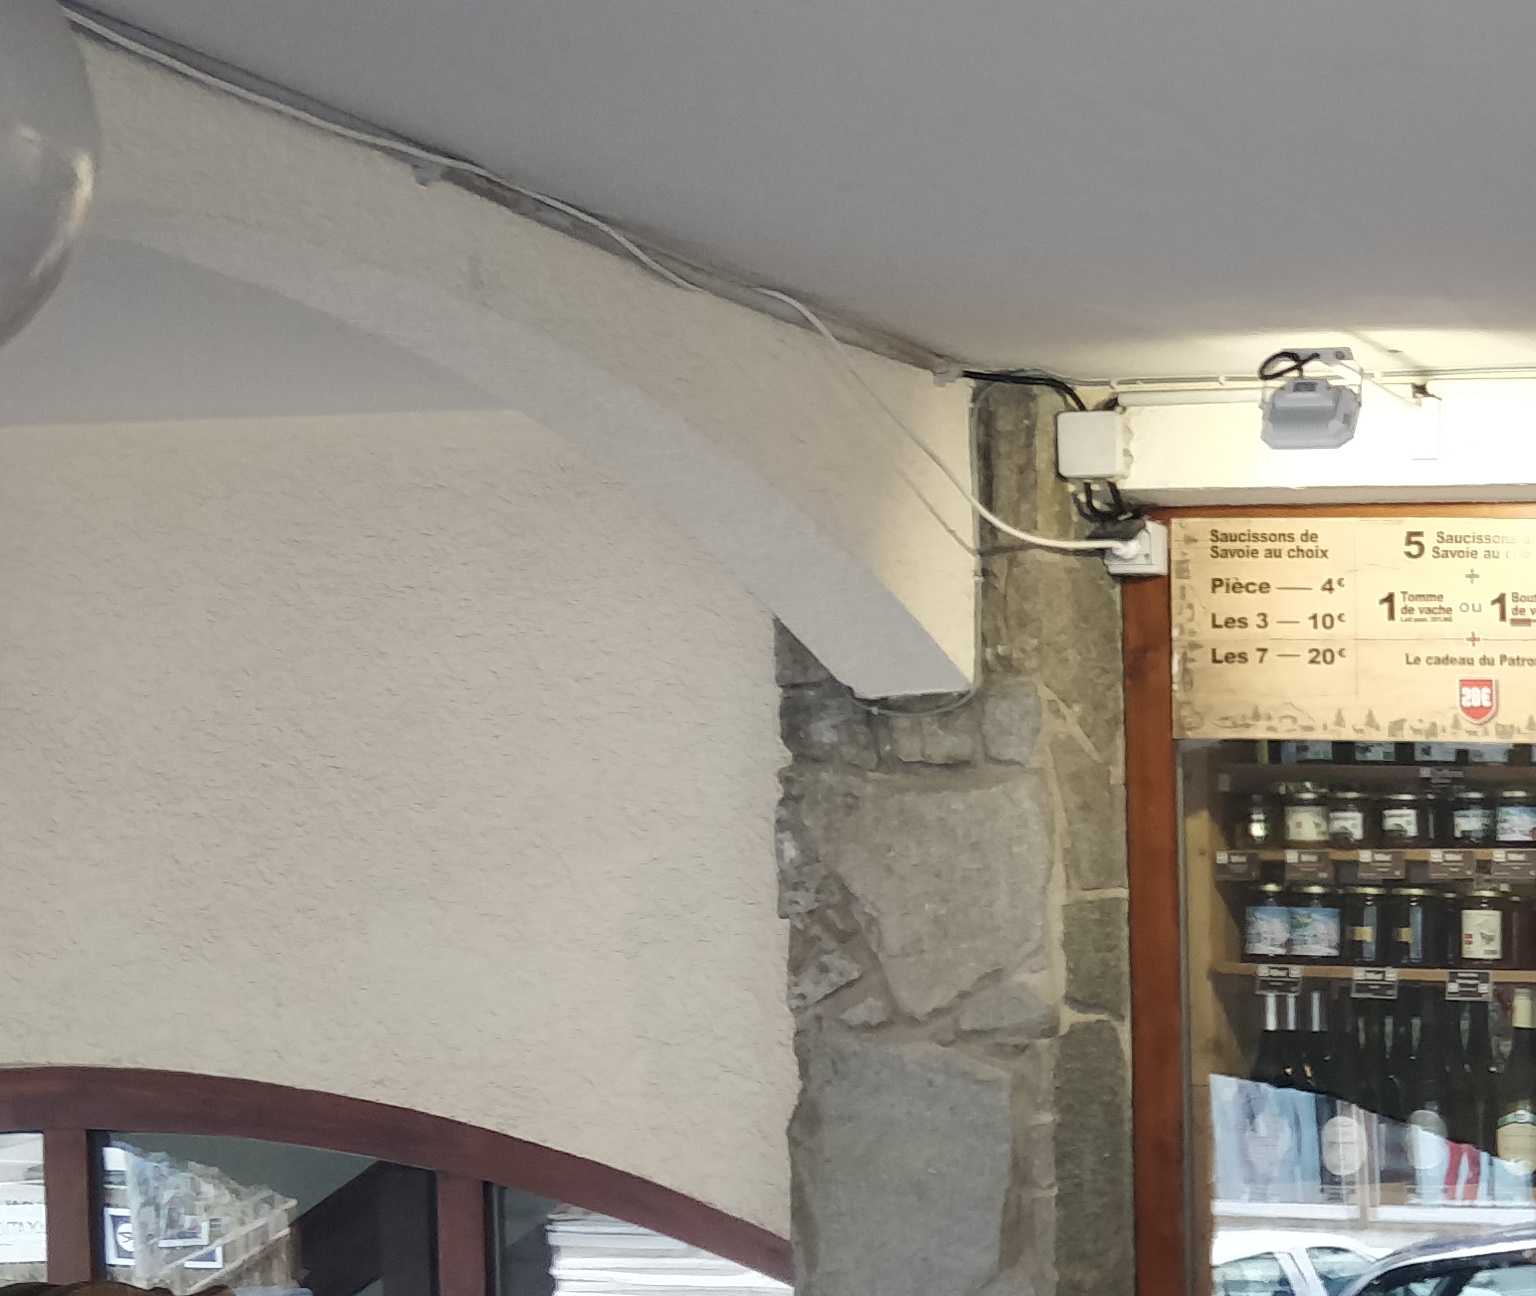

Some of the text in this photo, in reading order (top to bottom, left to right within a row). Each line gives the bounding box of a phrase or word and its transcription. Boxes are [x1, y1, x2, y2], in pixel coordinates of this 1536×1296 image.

[1210, 529, 1319, 543] Saucissons de
[1210, 545, 1329, 559] Savoie au choix
[1403, 531, 1425, 559] 5
[1432, 546, 1478, 559] Savoie
[1484, 549, 1500, 559] au
[1211, 577, 1271, 594] Pièce
[1401, 591, 1444, 602] Tomme
[1379, 592, 1396, 621] 1
[1401, 604, 1453, 615] de vache
[1459, 602, 1482, 614] ou
[1491, 593, 1507, 622] 1
[1512, 605, 1526, 616] de
[1211, 612, 1249, 629] Les
[1256, 612, 1269, 629] 3
[1211, 648, 1249, 664] Les
[1255, 647, 1268, 664] 7
[1405, 653, 1421, 666] Le
[1426, 654, 1475, 666] cadeau
[1479, 654, 1495, 666] du
[1461, 686, 1492, 708] 20€
